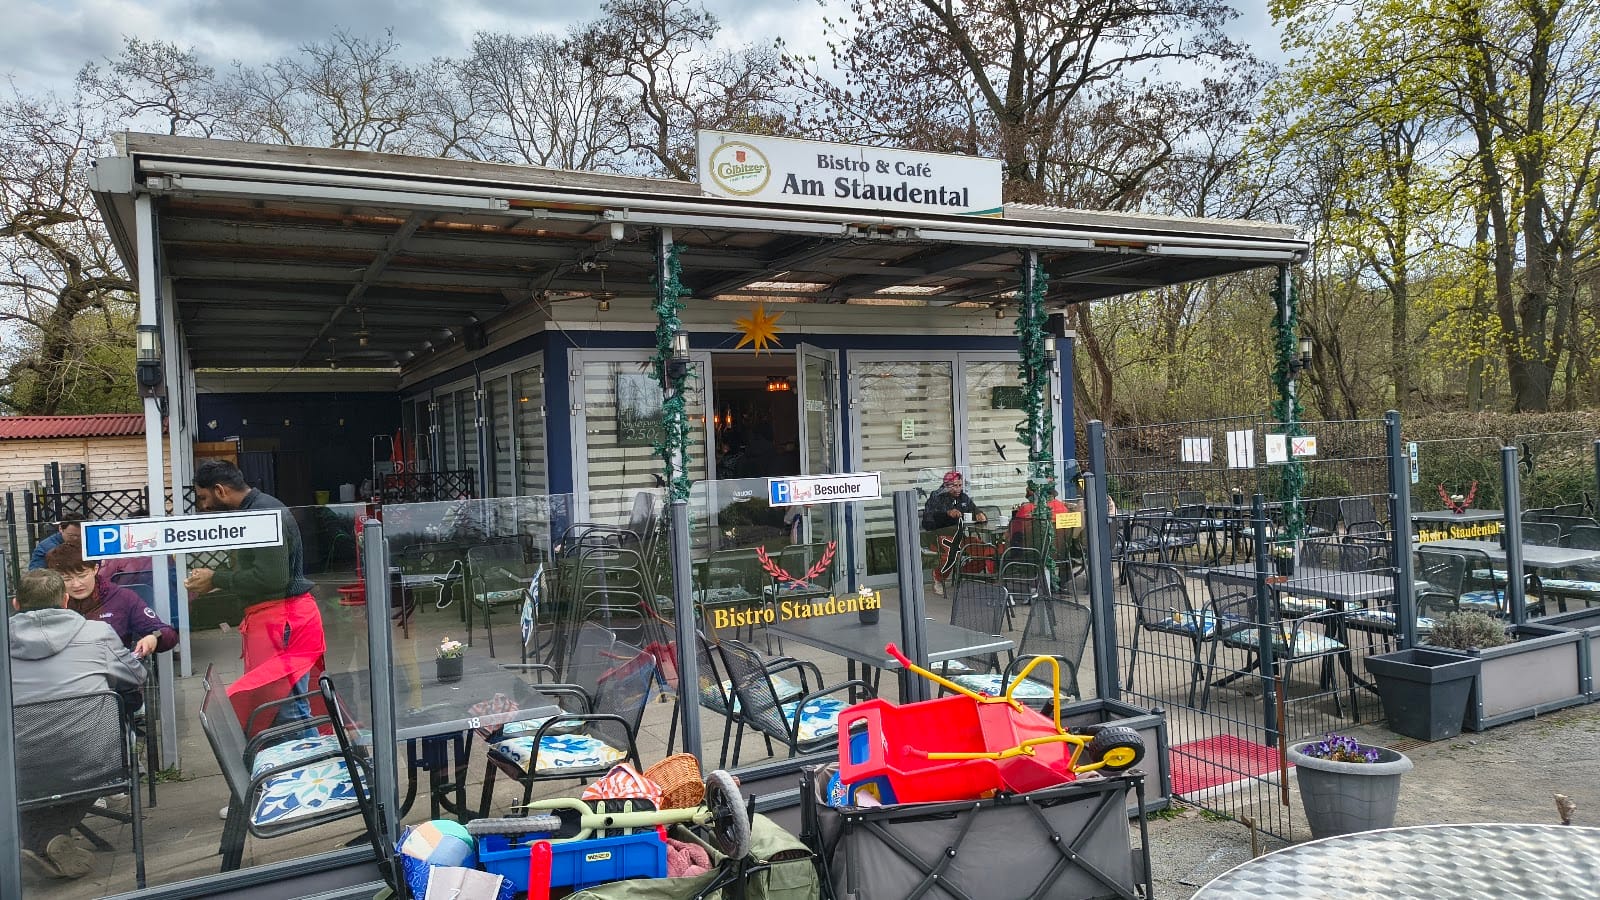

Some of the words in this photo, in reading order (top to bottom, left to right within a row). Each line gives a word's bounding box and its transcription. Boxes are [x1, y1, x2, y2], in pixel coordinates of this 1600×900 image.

[718, 162, 765, 179] Colbitzer
[817, 154, 870, 172] Bistro
[876, 159, 890, 174] &
[894, 161, 932, 178] Café
[781, 173, 825, 197] Am
[834, 177, 969, 207] Staudental
[778, 482, 789, 501] P
[813, 483, 861, 496] Besucher
[98, 528, 119, 552] P
[164, 524, 247, 544] Besucher
[1418, 529, 1448, 543] Bistro
[1450, 522, 1500, 539] Staudental
[714, 607, 775, 629] Bistro
[781, 591, 882, 621] Staudental
[468, 717, 481, 728] 18
